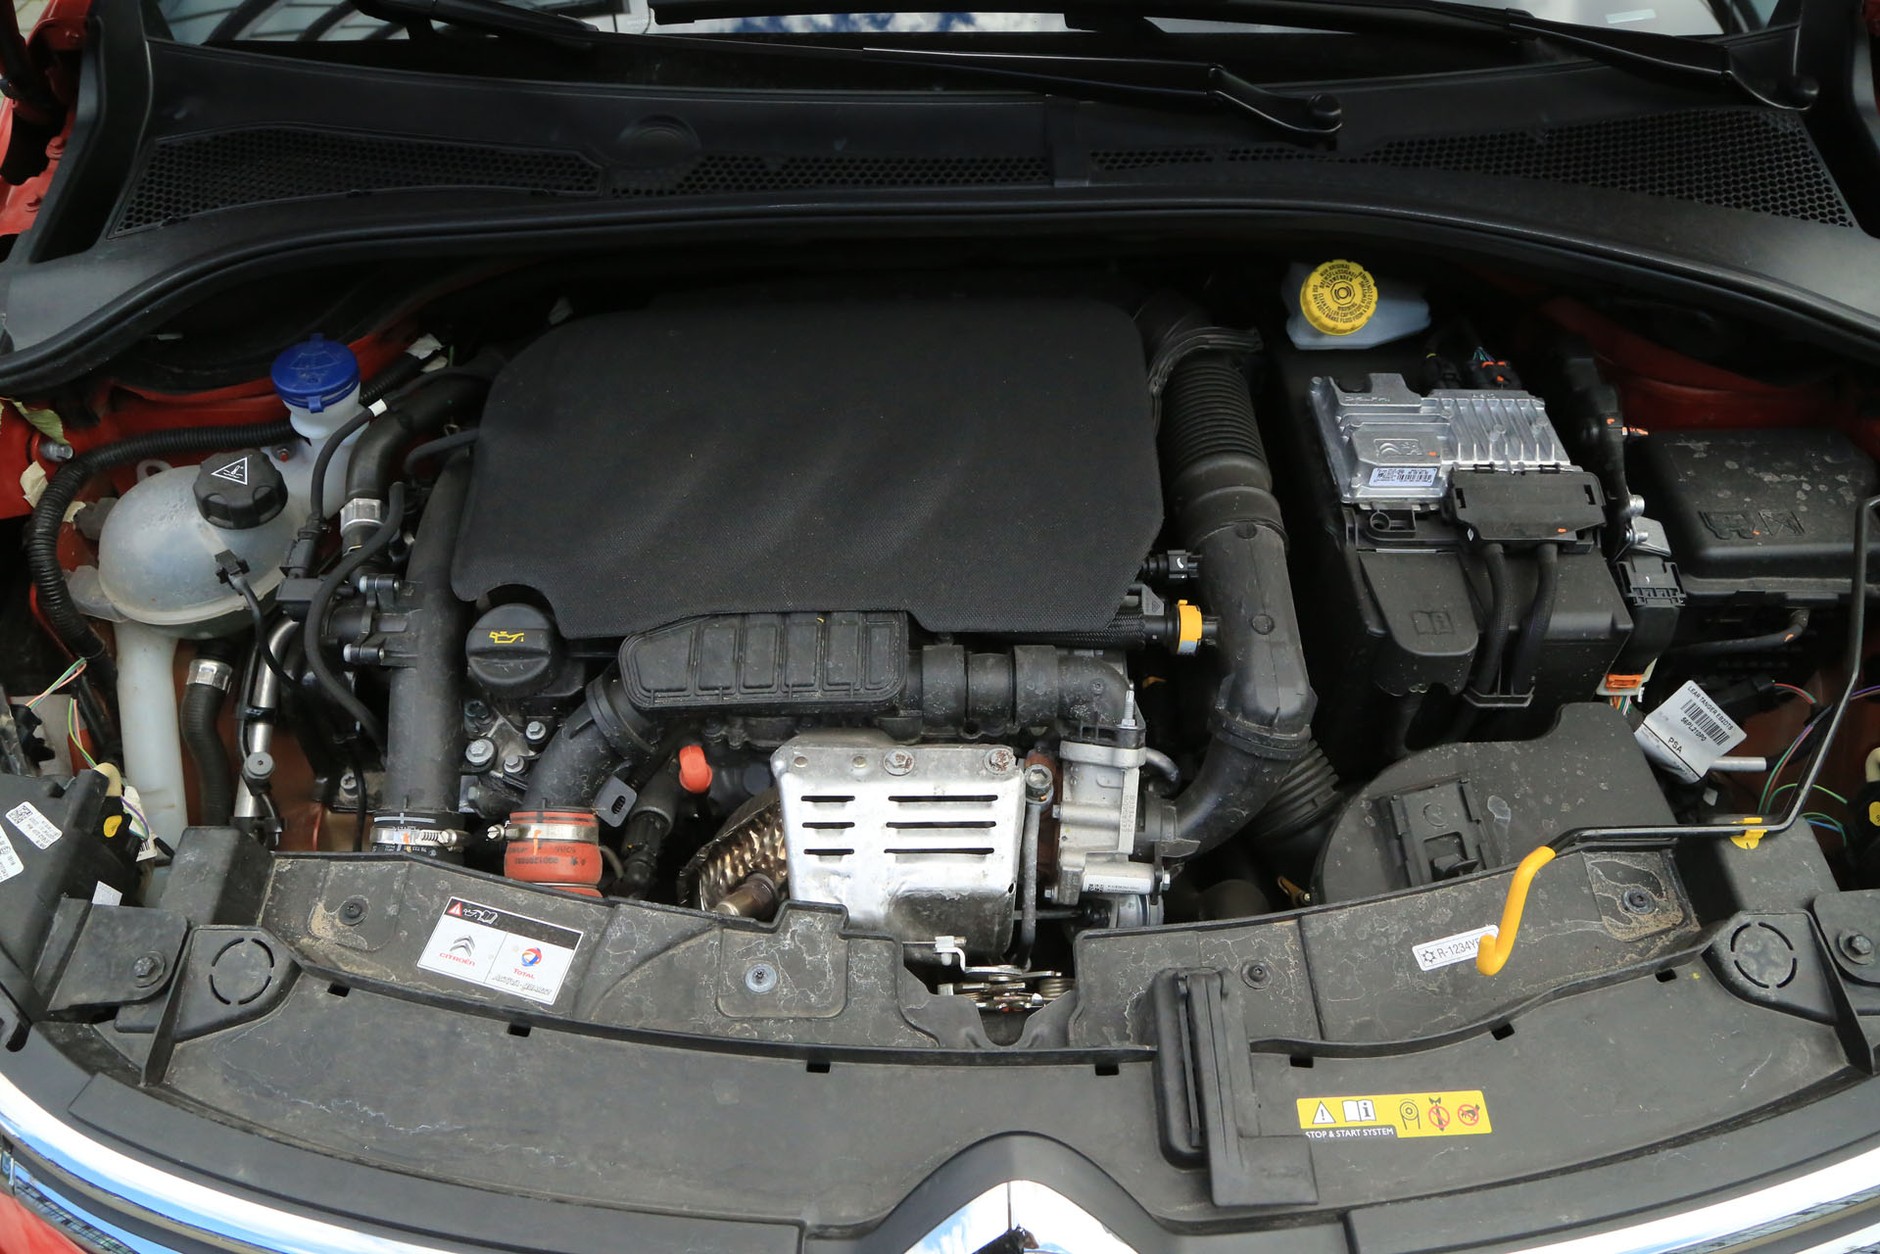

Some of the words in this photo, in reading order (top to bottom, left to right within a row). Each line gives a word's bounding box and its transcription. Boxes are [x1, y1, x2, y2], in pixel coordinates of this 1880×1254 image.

[1687, 685, 1701, 699] LEAR
[1700, 697, 1718, 717] TANGER
[1667, 736, 1683, 754] PSA
[438, 952, 476, 967] CITROËN
[513, 968, 535, 980] TOTAL
[1305, 1130, 1327, 1139] STOP
[1328, 1130, 1335, 1138] &
[1336, 1129, 1361, 1137] START
[1362, 1128, 1394, 1137] SYSTEM
